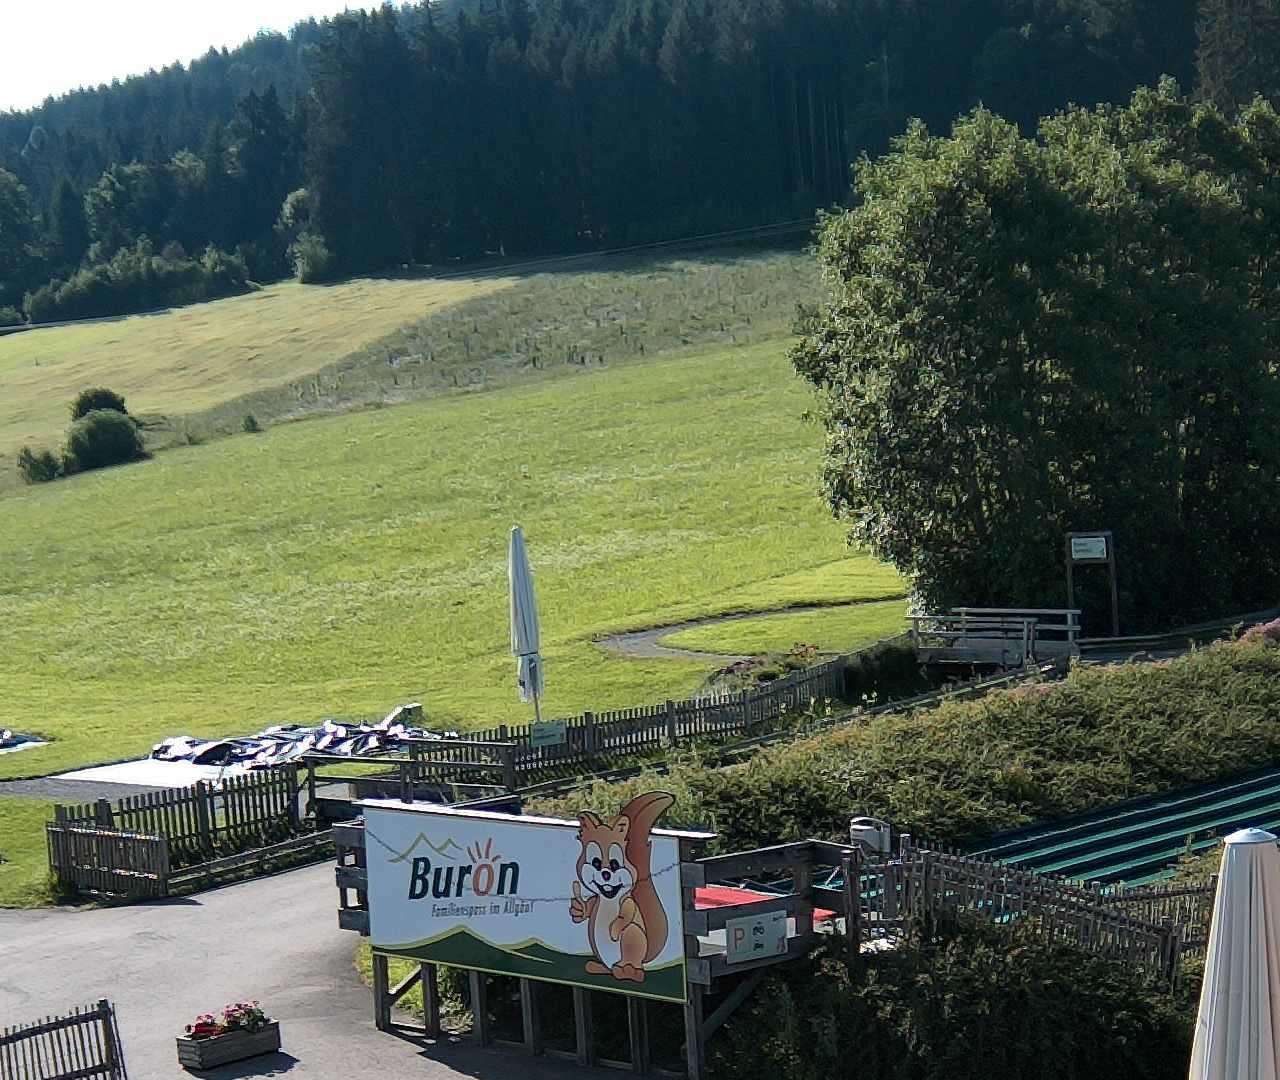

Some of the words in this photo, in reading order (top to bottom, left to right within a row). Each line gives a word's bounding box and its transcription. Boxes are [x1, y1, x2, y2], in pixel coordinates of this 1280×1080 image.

[408, 856, 520, 899] Buron
[490, 902, 501, 914] im
[733, 927, 745, 951] P
